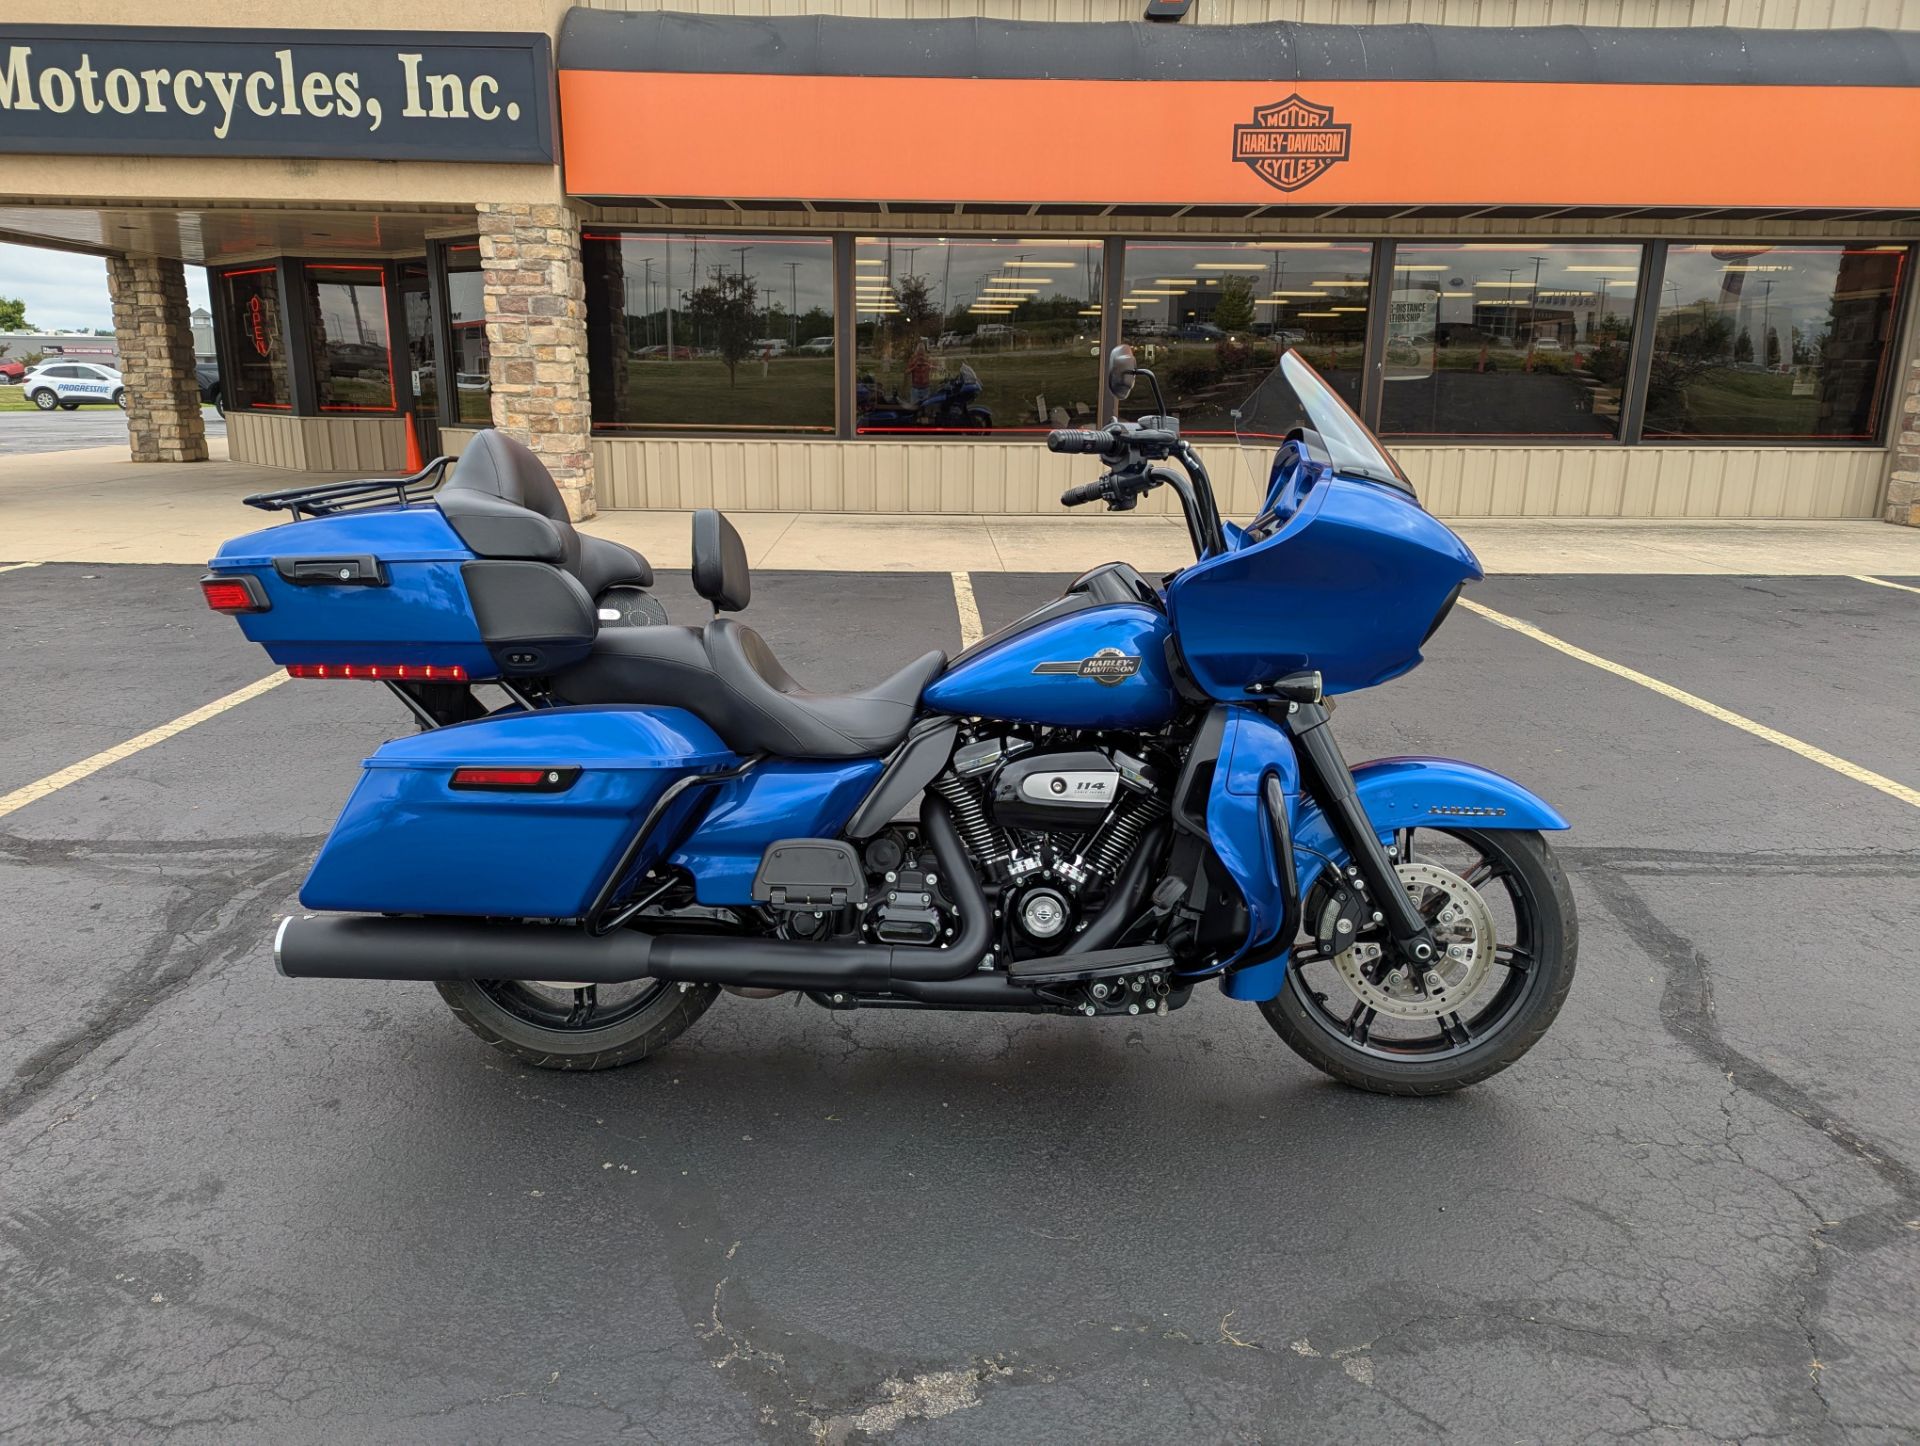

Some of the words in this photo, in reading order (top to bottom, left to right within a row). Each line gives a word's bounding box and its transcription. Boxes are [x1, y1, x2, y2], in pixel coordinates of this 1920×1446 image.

[0, 46, 382, 139] Motorcycles,
[398, 53, 520, 121] Inc.
[1267, 105, 1320, 126] MOTOR
[1242, 133, 1341, 153] HARLEY-DAVIDSON
[1263, 159, 1316, 183] CYCLES
[251, 297, 266, 354] OPEN
[58, 383, 110, 393] PROGRESSIVE
[1077, 782, 1105, 790] 114
